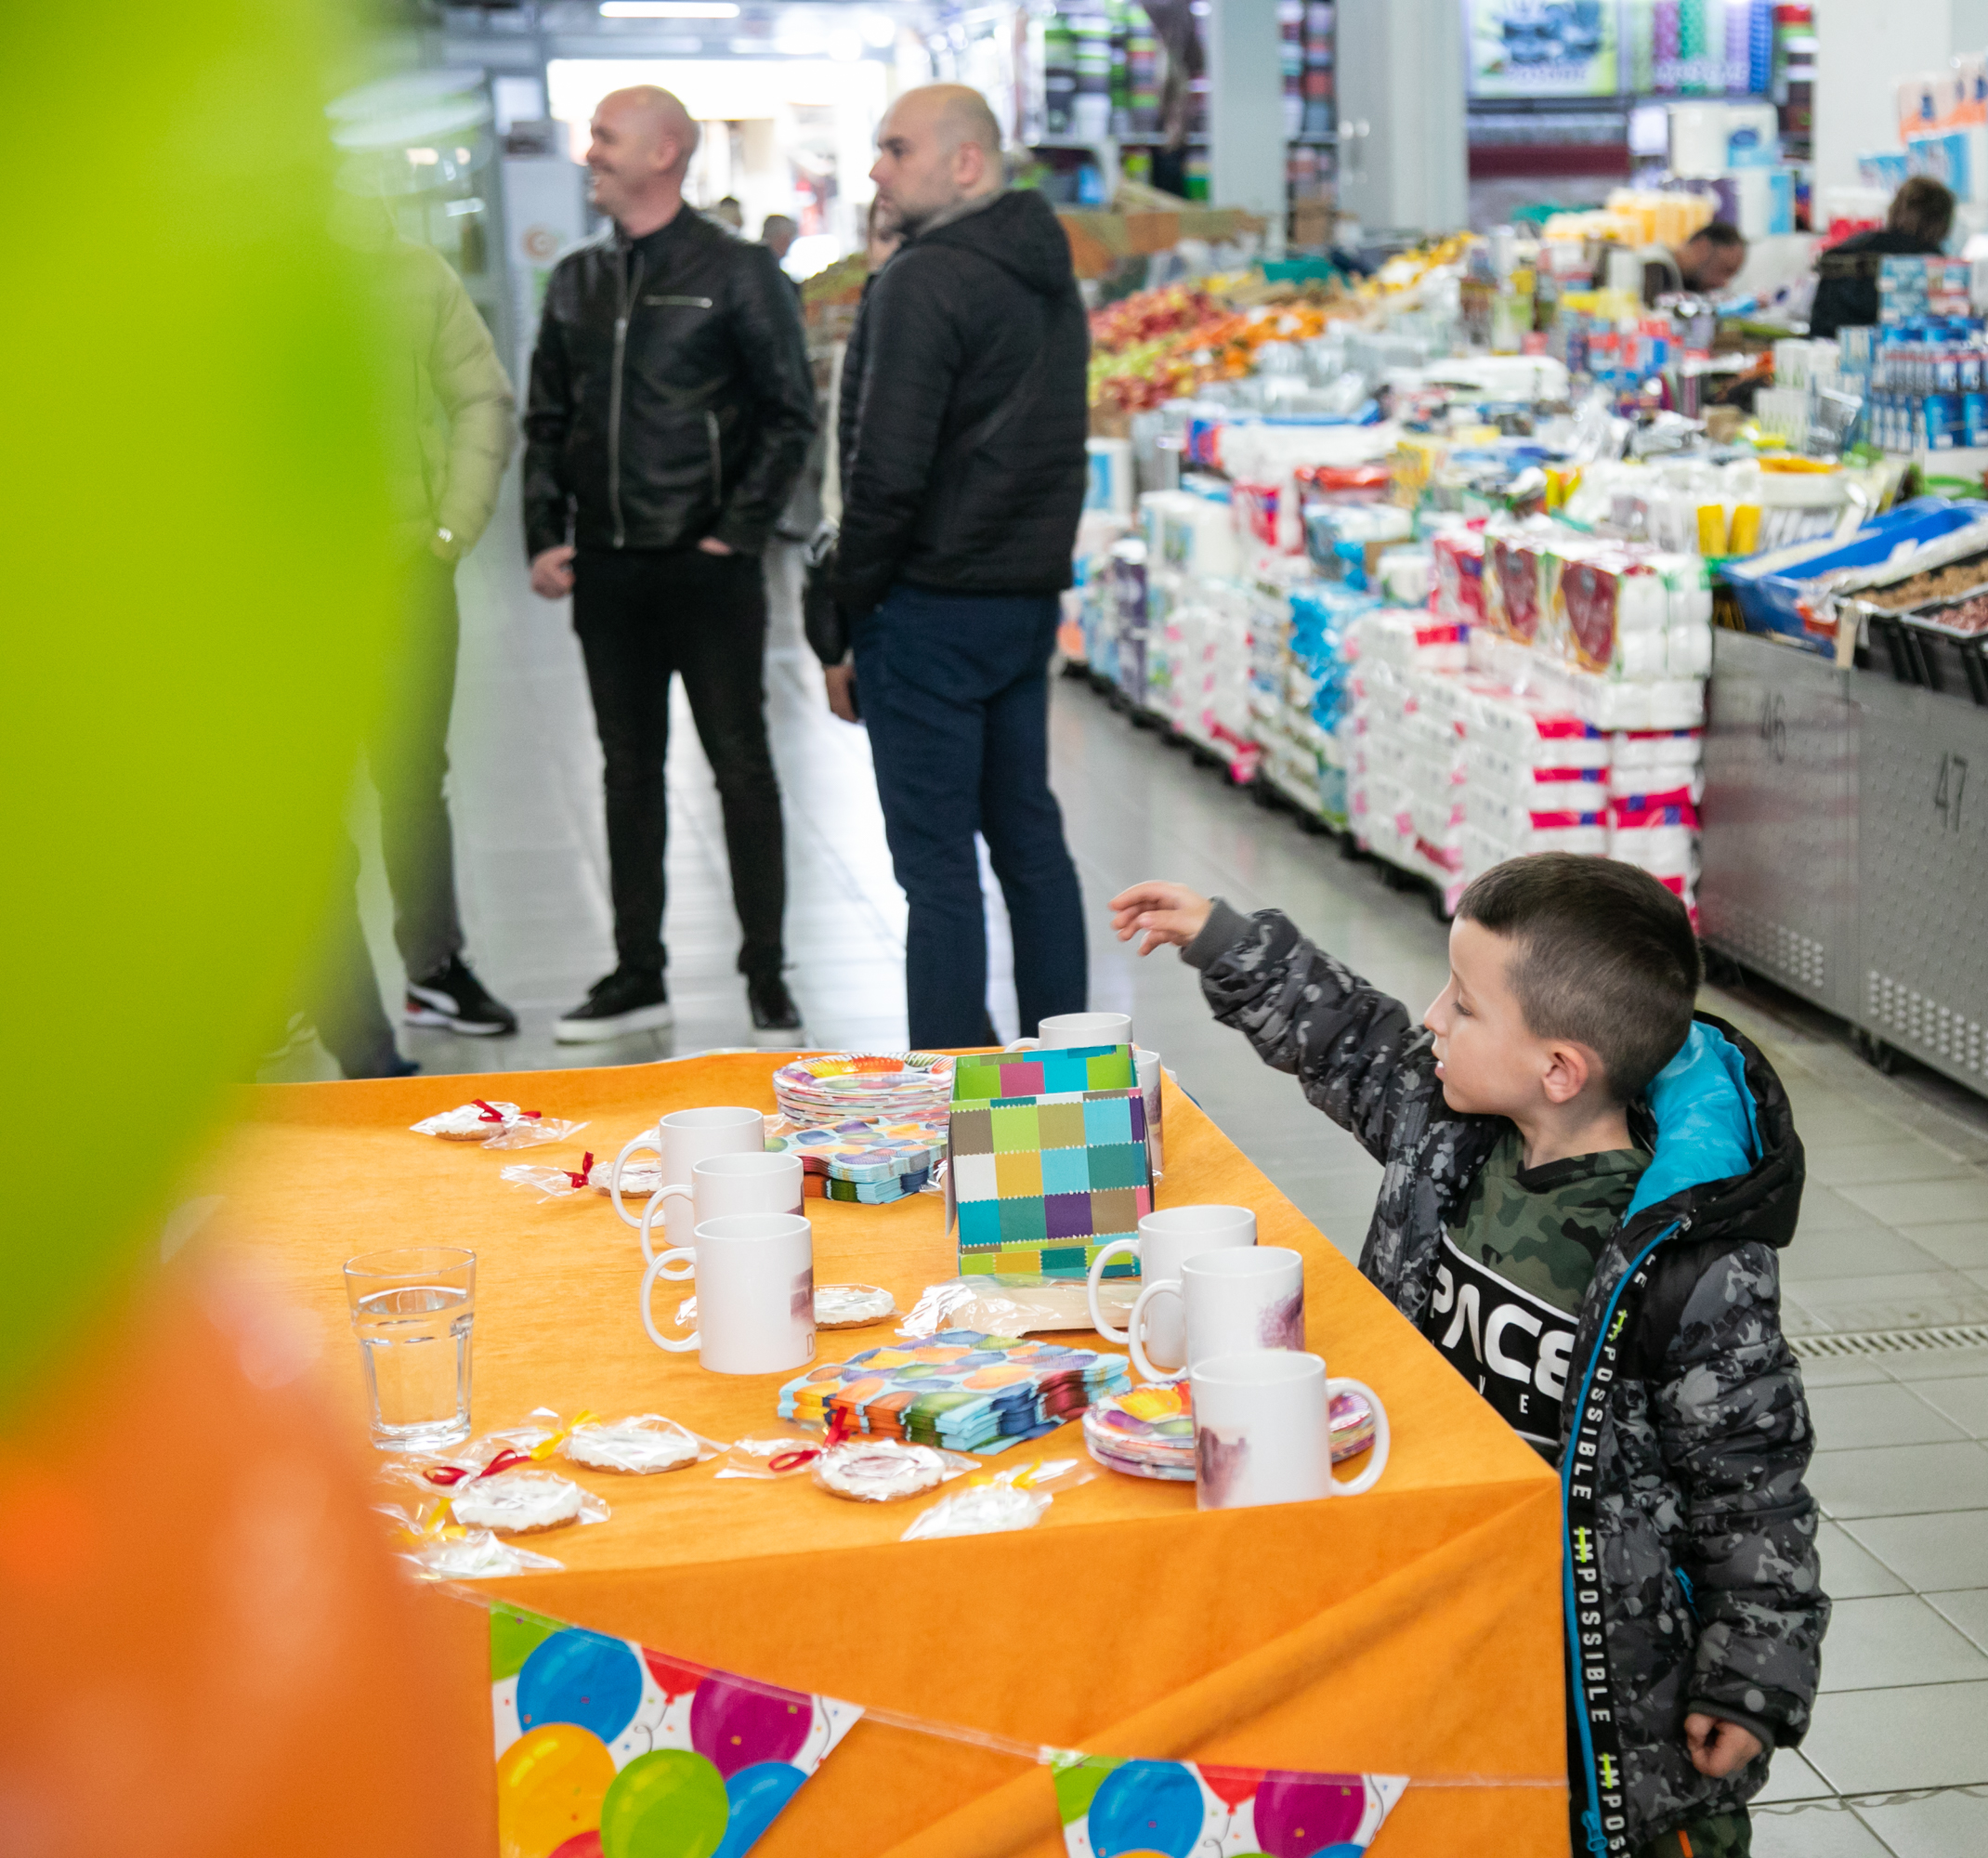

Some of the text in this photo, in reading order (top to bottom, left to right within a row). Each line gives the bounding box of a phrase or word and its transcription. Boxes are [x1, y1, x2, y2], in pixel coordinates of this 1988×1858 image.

[1934, 751, 1968, 833] 47
[1572, 1309, 1628, 1500] IMPOSSIBLE
[1573, 1526, 1612, 1723] IMPOSSIBLE
